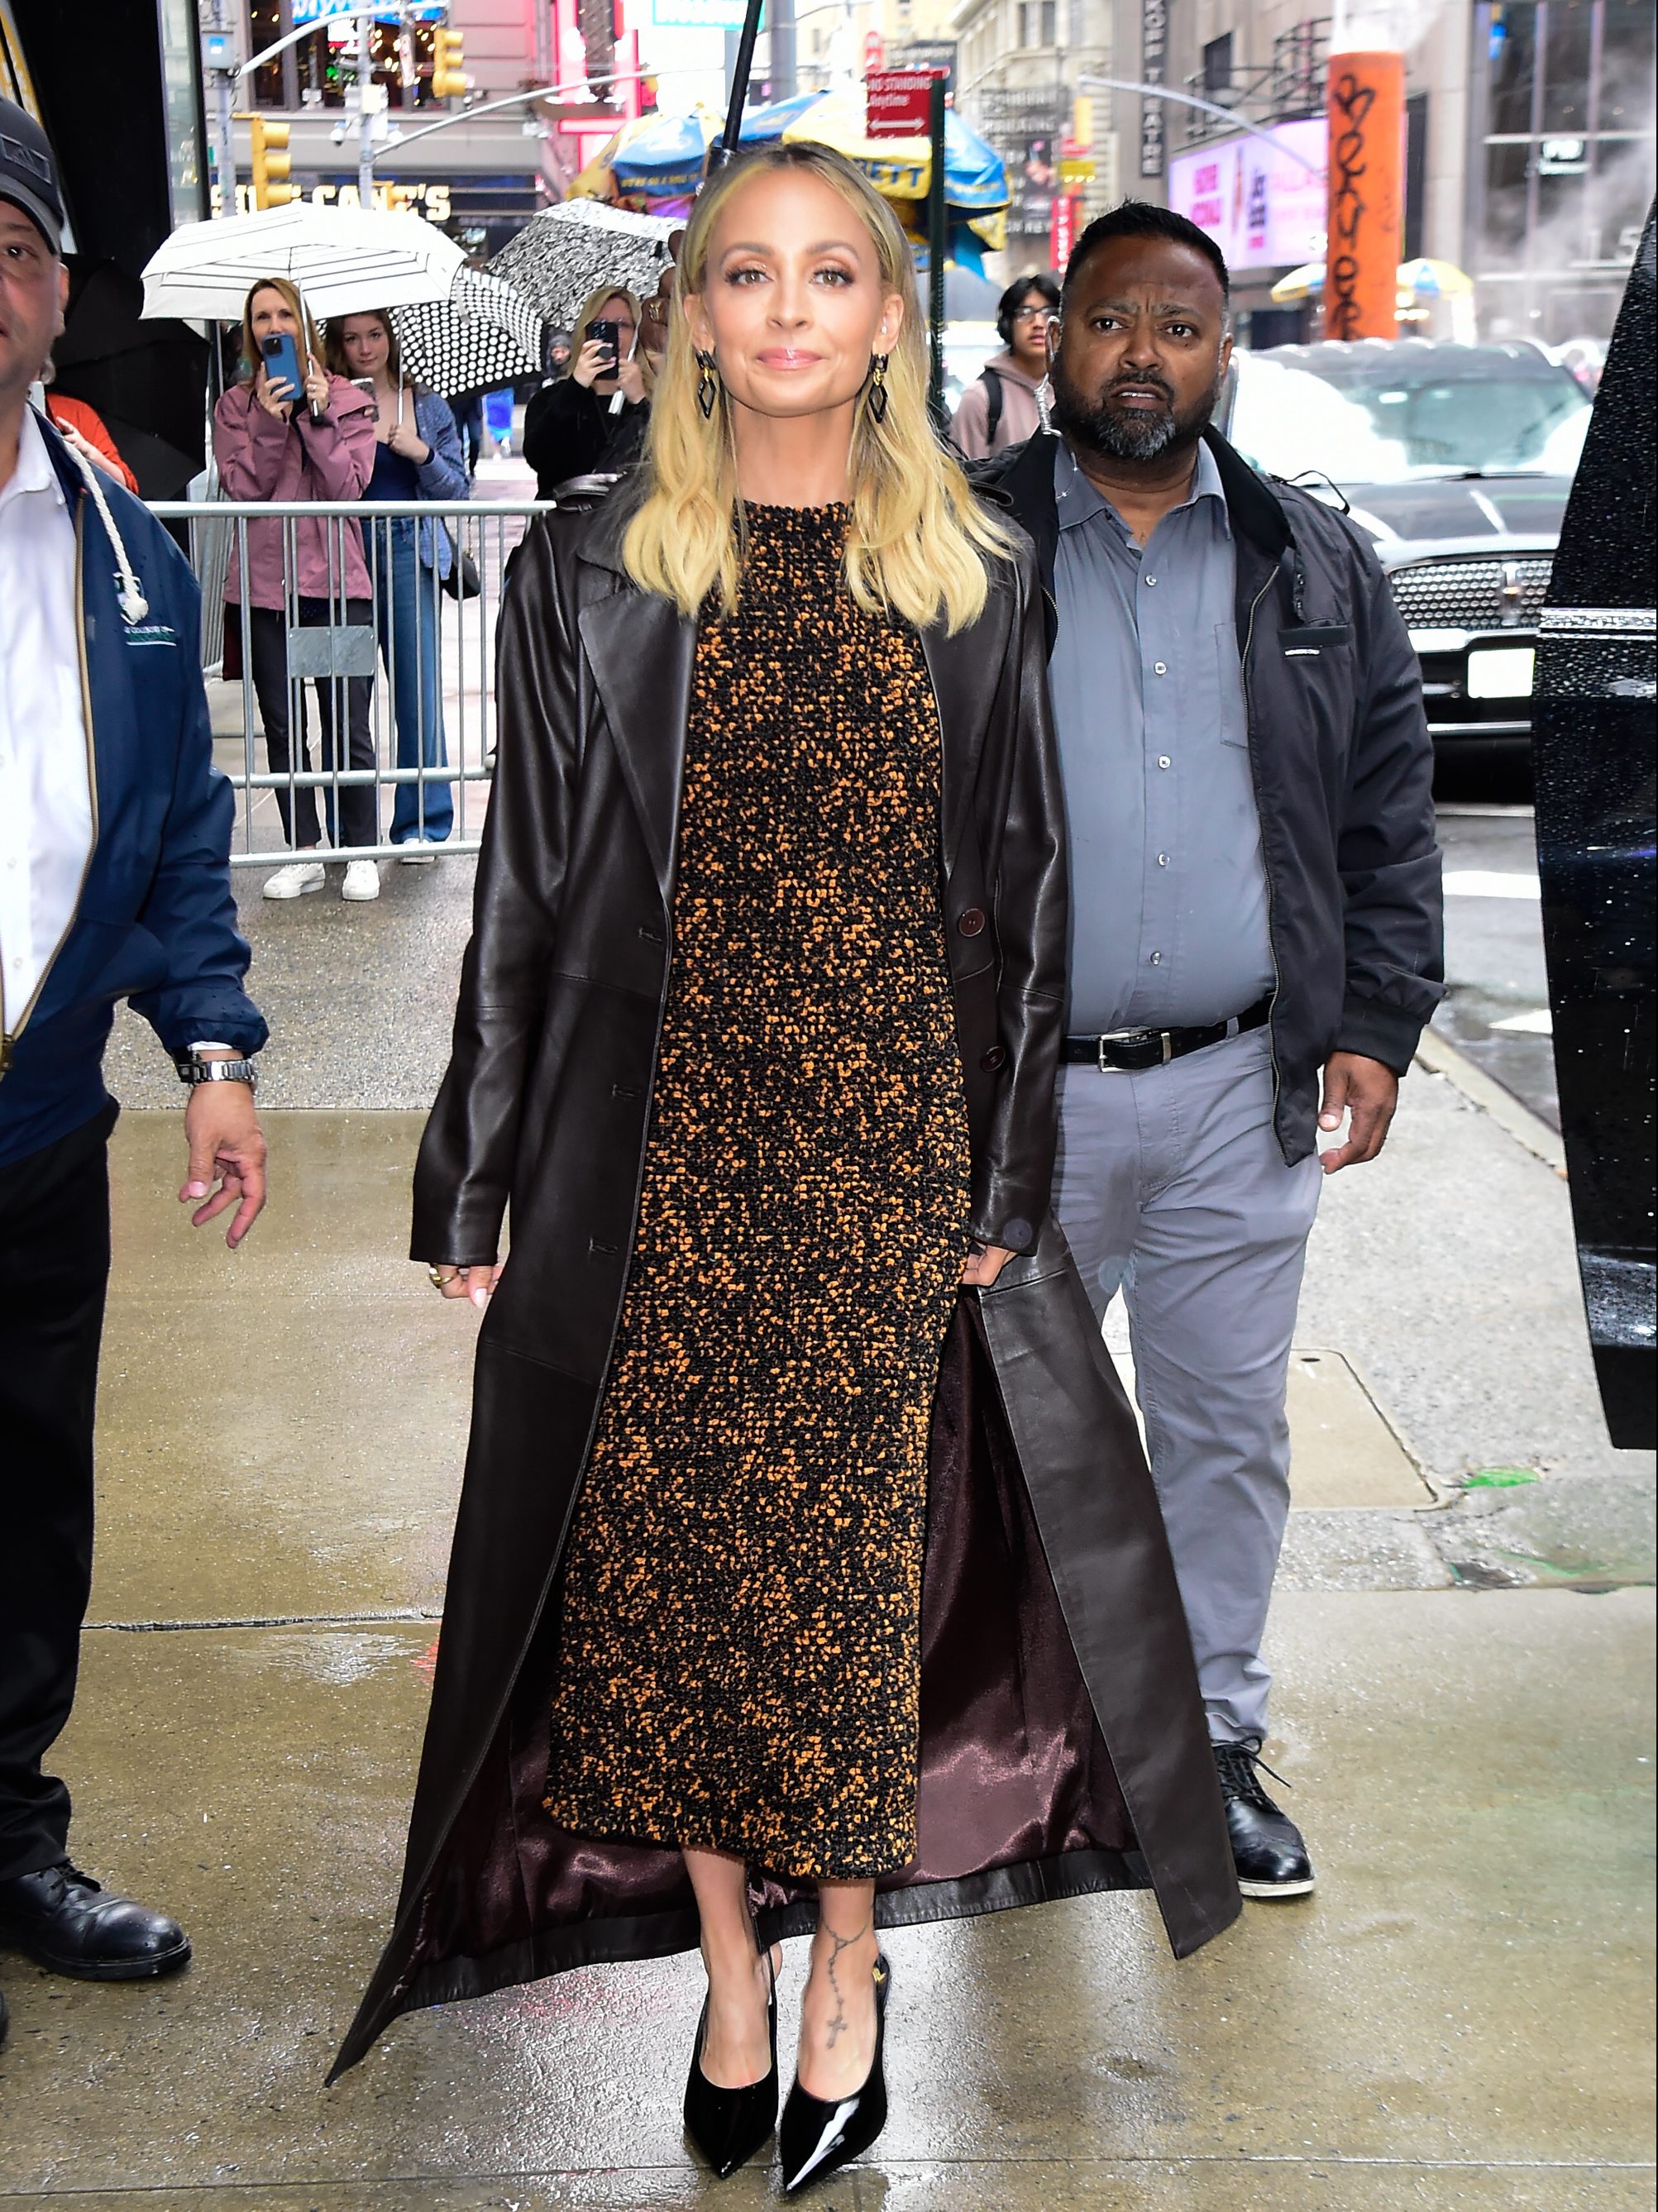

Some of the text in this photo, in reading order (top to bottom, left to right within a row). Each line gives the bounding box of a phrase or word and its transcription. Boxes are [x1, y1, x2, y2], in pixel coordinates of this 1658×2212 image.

[884, 76, 933, 91] STANDING
[869, 93, 910, 110] Anytime
[1143, 67, 1164, 174] TEATRE
